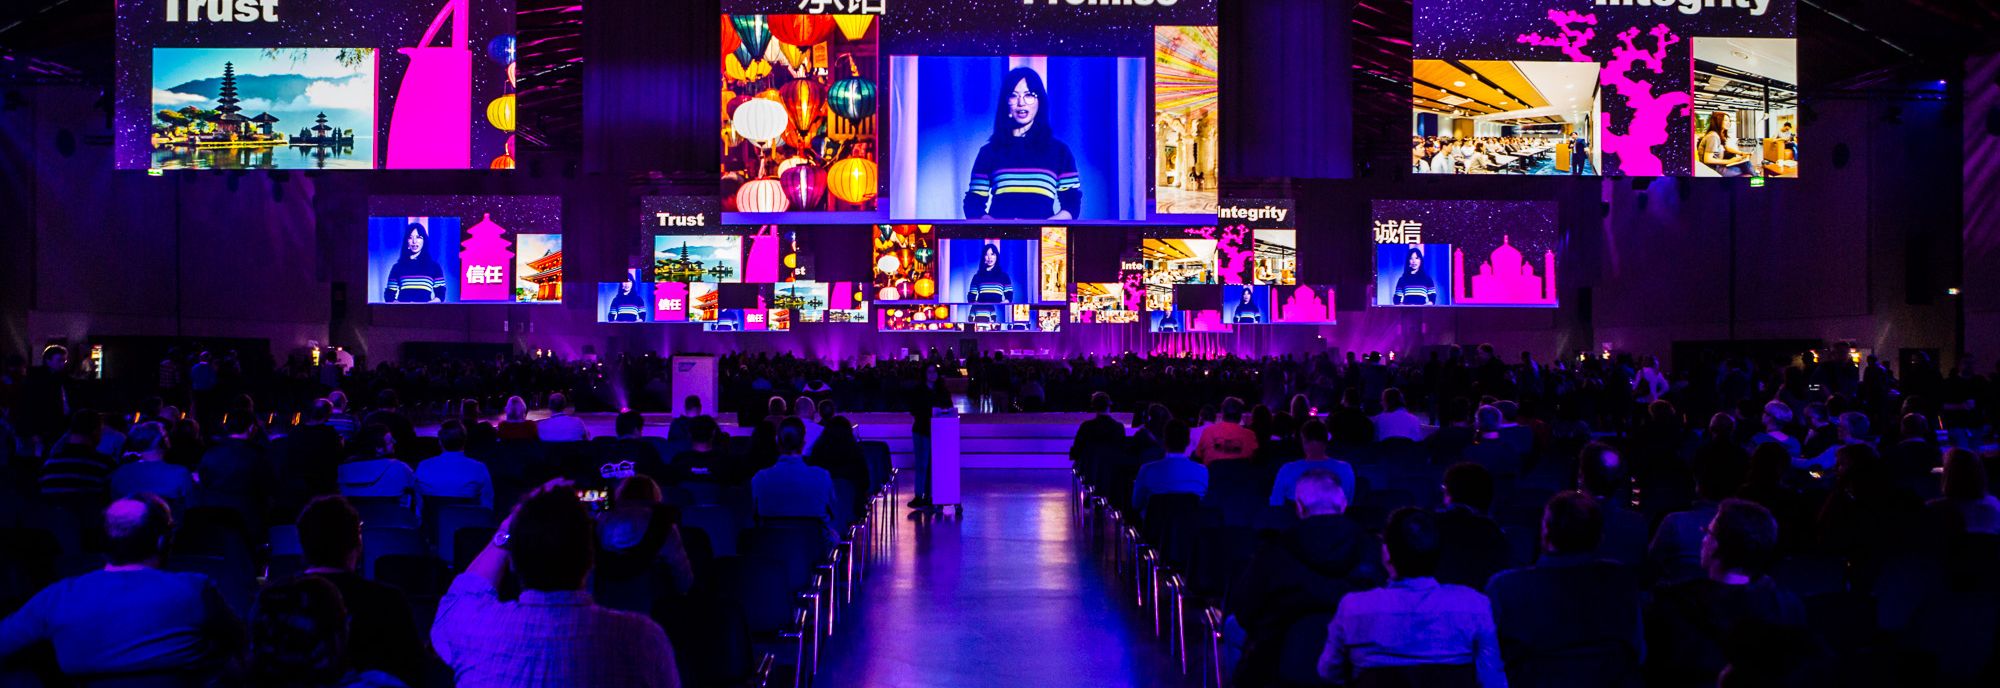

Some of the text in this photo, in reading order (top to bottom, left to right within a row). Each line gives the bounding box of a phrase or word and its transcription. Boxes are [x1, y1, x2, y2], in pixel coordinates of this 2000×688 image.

[657, 212, 705, 226] Trust
[1217, 205, 1288, 222] Integrity
[1373, 220, 1423, 244] 诚信
[466, 265, 503, 284] 信任
